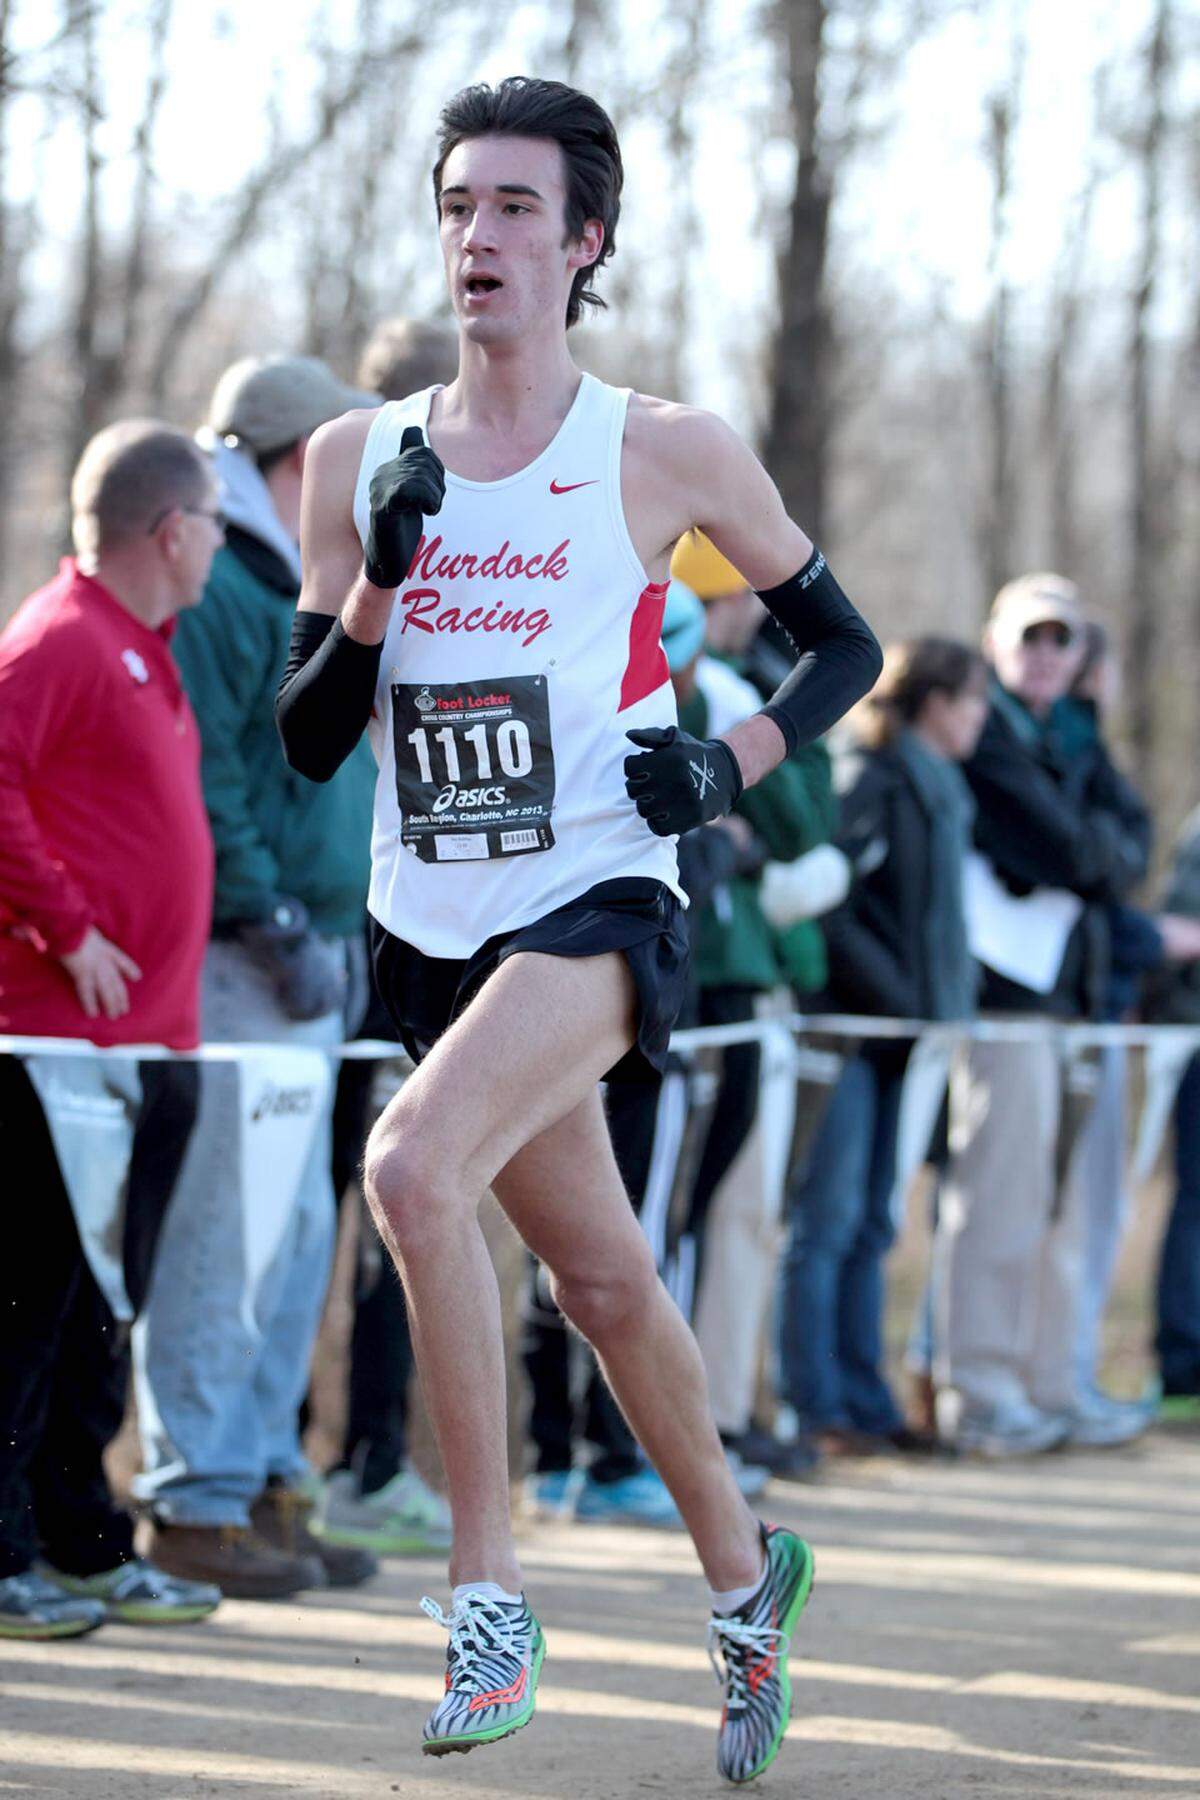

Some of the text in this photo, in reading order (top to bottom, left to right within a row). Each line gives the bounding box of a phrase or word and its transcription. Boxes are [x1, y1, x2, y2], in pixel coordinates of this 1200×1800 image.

[406, 534, 571, 582] Murdock
[401, 588, 552, 647] Racing
[408, 720, 533, 783] 1110
[505, 808, 519, 817] NC
[520, 805, 543, 816] 2013
